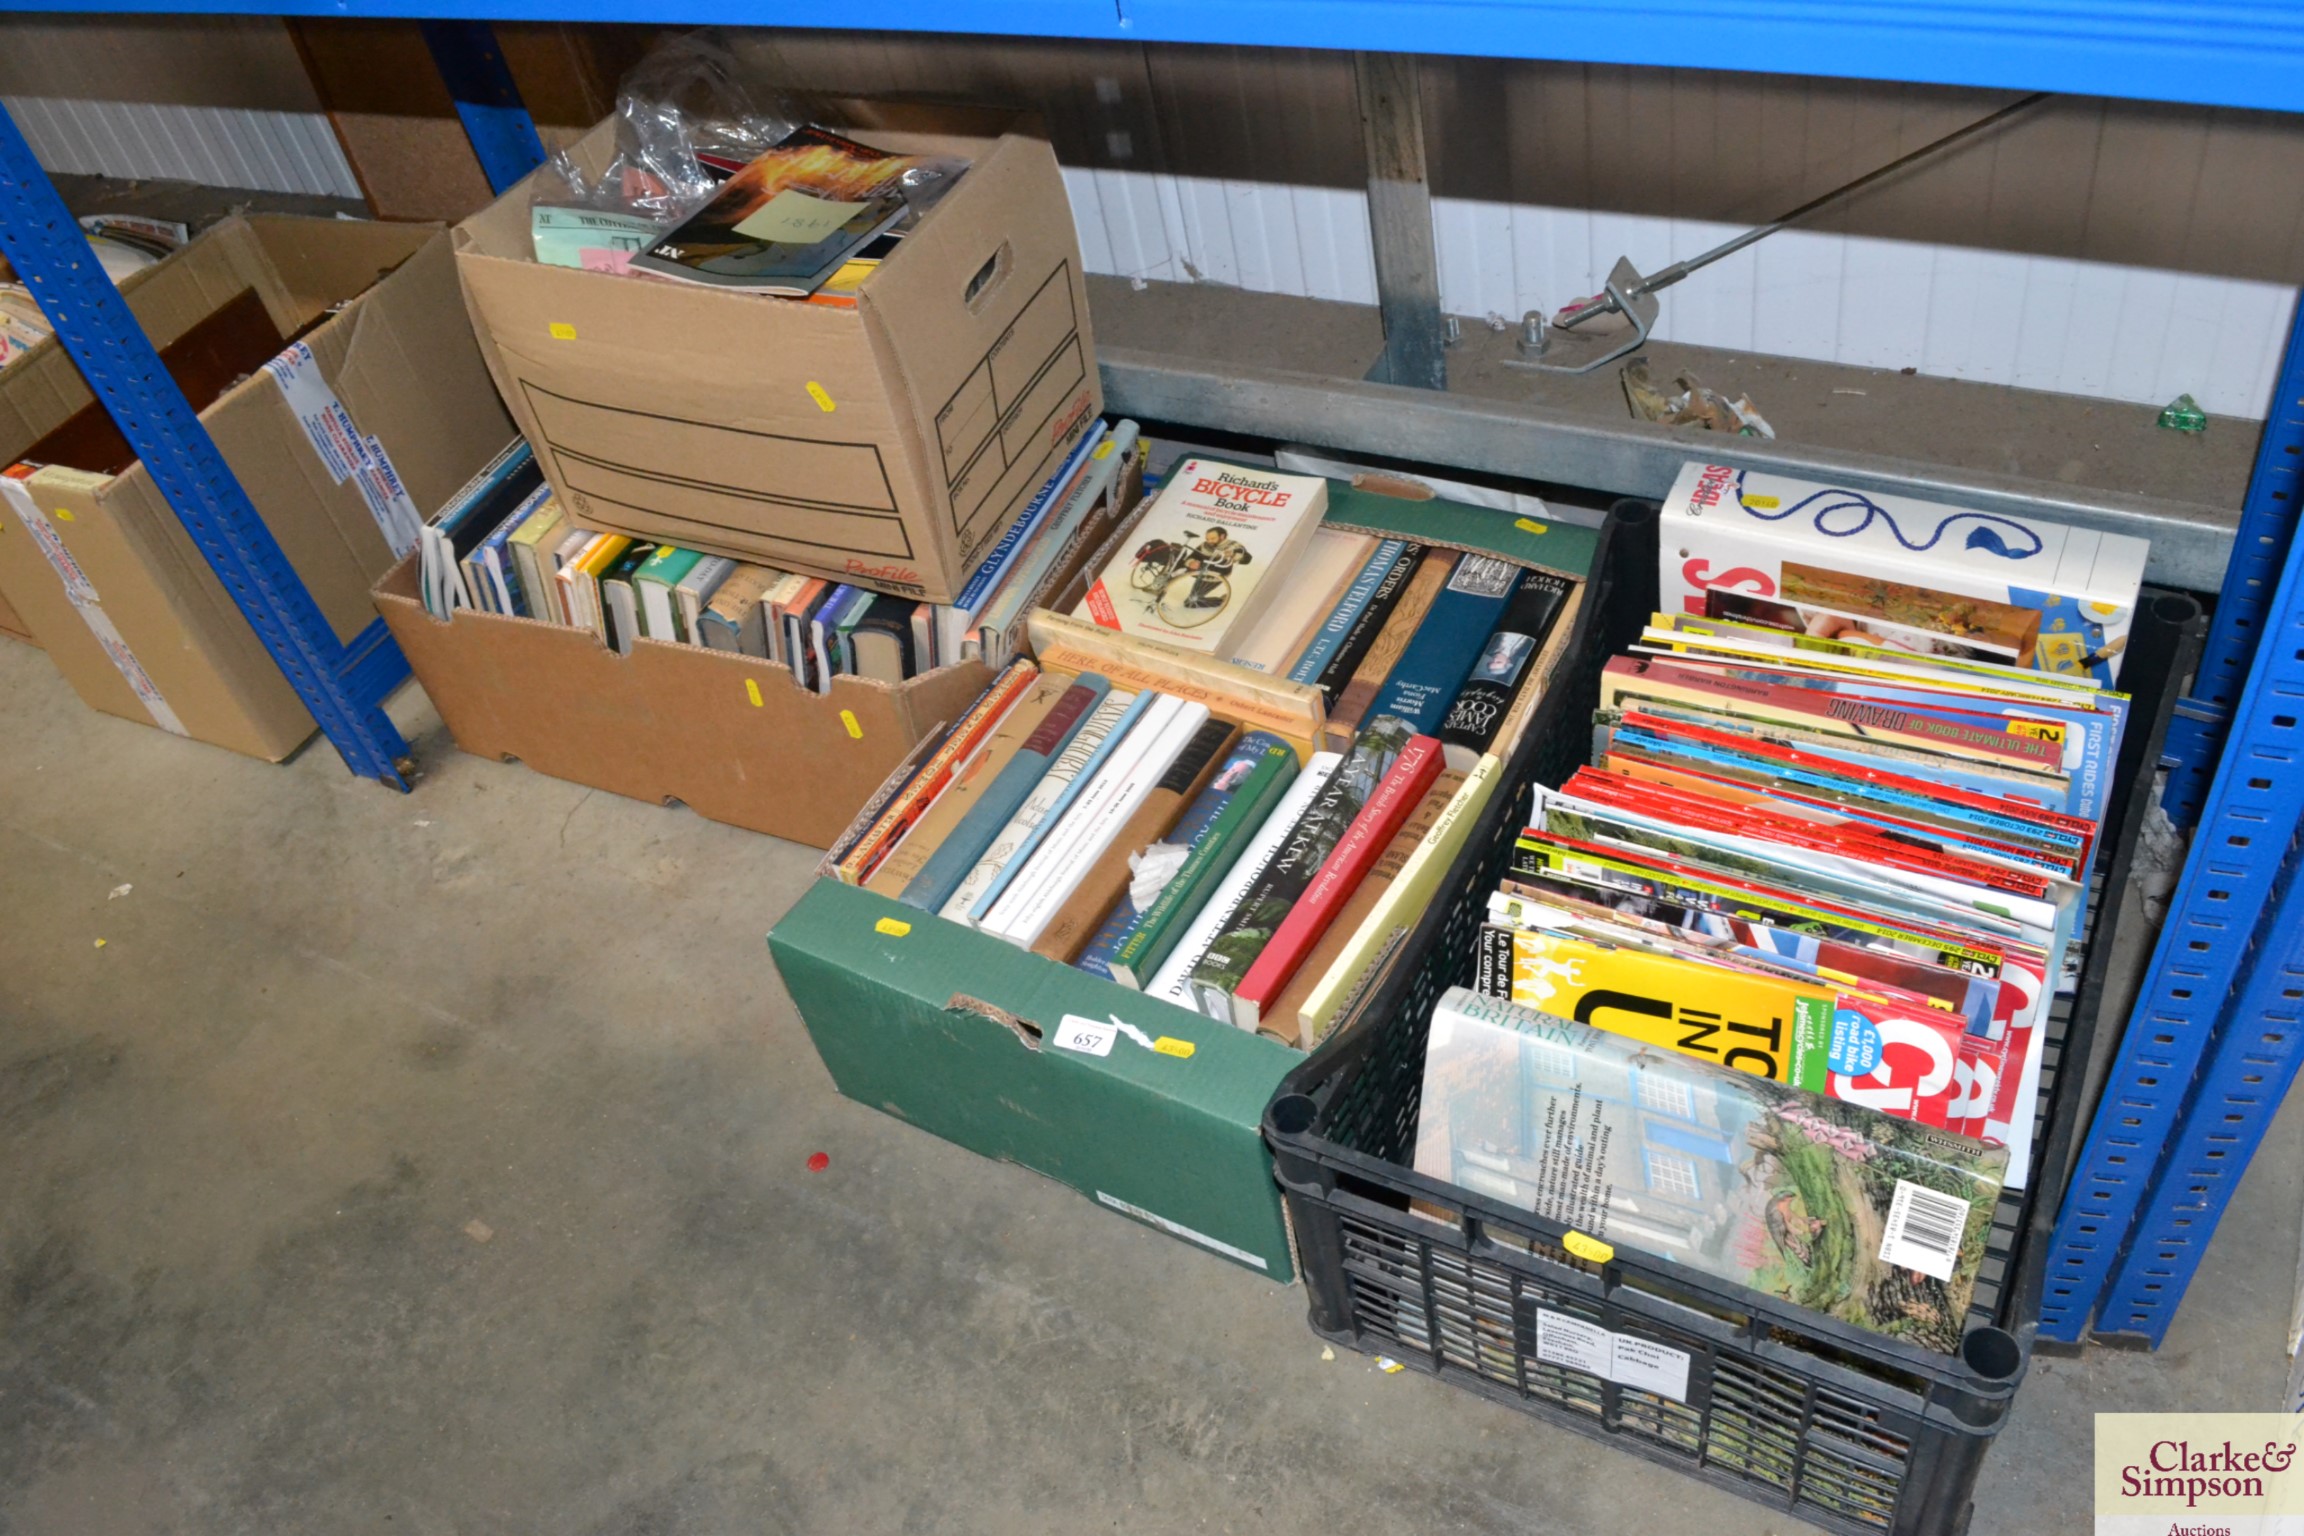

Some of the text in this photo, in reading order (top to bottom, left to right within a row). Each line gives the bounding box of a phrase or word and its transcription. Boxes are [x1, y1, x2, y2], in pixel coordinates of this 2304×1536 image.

[338, 412, 374, 466] HUMPHREY
[371, 444, 405, 497] HUMPHREY
[1218, 472, 1279, 492] Richard's
[1691, 464, 1733, 506] IDEAS
[1050, 500, 1073, 530] GEOFFREY
[1070, 475, 1094, 502] FLETCHER
[1192, 478, 1292, 508] BICYCLE
[1214, 498, 1251, 512] Book
[981, 479, 1055, 574] GLYNDEBOURNE
[1186, 512, 1258, 531] RICHARD BALLANTINE
[845, 559, 919, 581] ProFile
[1360, 540, 1403, 584] THOMAS
[901, 585, 927, 597] FILE
[1376, 557, 1411, 600] ORDERS
[1327, 583, 1372, 632] TELFORD
[1100, 658, 1121, 674] OF
[1120, 664, 1150, 684] ALL
[1153, 674, 1211, 700] PLACES
[1396, 680, 1442, 694] MacCarthy
[1390, 702, 1422, 716] William
[1396, 696, 1425, 708] Morris
[1402, 690, 1426, 700] Fiona
[1455, 700, 1498, 716] COOK
[1449, 709, 1491, 728] JAMES
[1825, 698, 2046, 756] THE ULTIMATE BOOK OF DRAWING
[1349, 754, 1366, 770] A
[1400, 748, 1425, 774] 1776
[2079, 721, 2104, 797] FIRST RIDES
[1322, 770, 1359, 810] YEAR
[1389, 772, 1402, 788] The
[1374, 784, 1394, 809] British
[1999, 802, 2055, 822] 289 JULY 2014
[1306, 810, 1326, 835] AT
[1361, 803, 1380, 825] Story
[1428, 818, 1454, 845] Geoffrey
[1446, 792, 1470, 819] Fletcher
[1968, 812, 2043, 836] 293 OCTOBER 2014
[1351, 829, 1364, 842] the
[1276, 834, 1310, 875] KEW
[1330, 838, 1356, 872] American
[1952, 856, 1988, 871] JANUARY
[1121, 932, 1147, 959] FITTER
[1145, 915, 1158, 929] The
[1152, 892, 1175, 921] Wildlife
[1182, 853, 1204, 881] Thames
[1199, 828, 1222, 857] Counties
[1250, 882, 1274, 914] RUPERT
[1310, 870, 1338, 905] Revolution
[1484, 930, 1496, 954] Your
[1876, 926, 1960, 953] 295 DECEMBER 2014
[1168, 953, 1202, 997] DAVID
[1202, 958, 1226, 970] BOOKS
[1498, 933, 1510, 987] Le Tour de
[1462, 1002, 1577, 1046] BRITAIN
[1472, 994, 1576, 1030] NATURAL
[1818, 1004, 1828, 1048] SPONSORED BY
[1073, 1032, 1103, 1048] 657
[1677, 1008, 1722, 1054] IN
[1829, 1021, 1849, 1061] listing
[1844, 1014, 1862, 1073] road bike
[1860, 1028, 1876, 1069] £1,000
[1533, 1095, 1557, 1196] encroaches ever further
[1547, 1109, 1569, 1195] nature still manages
[1553, 1081, 1583, 1221] most man-made of environments.
[1597, 1124, 1612, 1154] outing
[1564, 1143, 1586, 1214] illustrated guide
[1574, 1099, 1604, 1227] the wealth of animal and plant
[1593, 1154, 1607, 1177] day's
[1588, 1184, 1600, 1213] within
[1600, 1183, 1614, 1230] your home.
[1882, 1242, 1893, 1259] ISBN
[1617, 1344, 1660, 1360] Pak Choi
[1617, 1352, 1660, 1370] Cabbage
[1618, 1337, 1685, 1360] UK PRODUCT:
